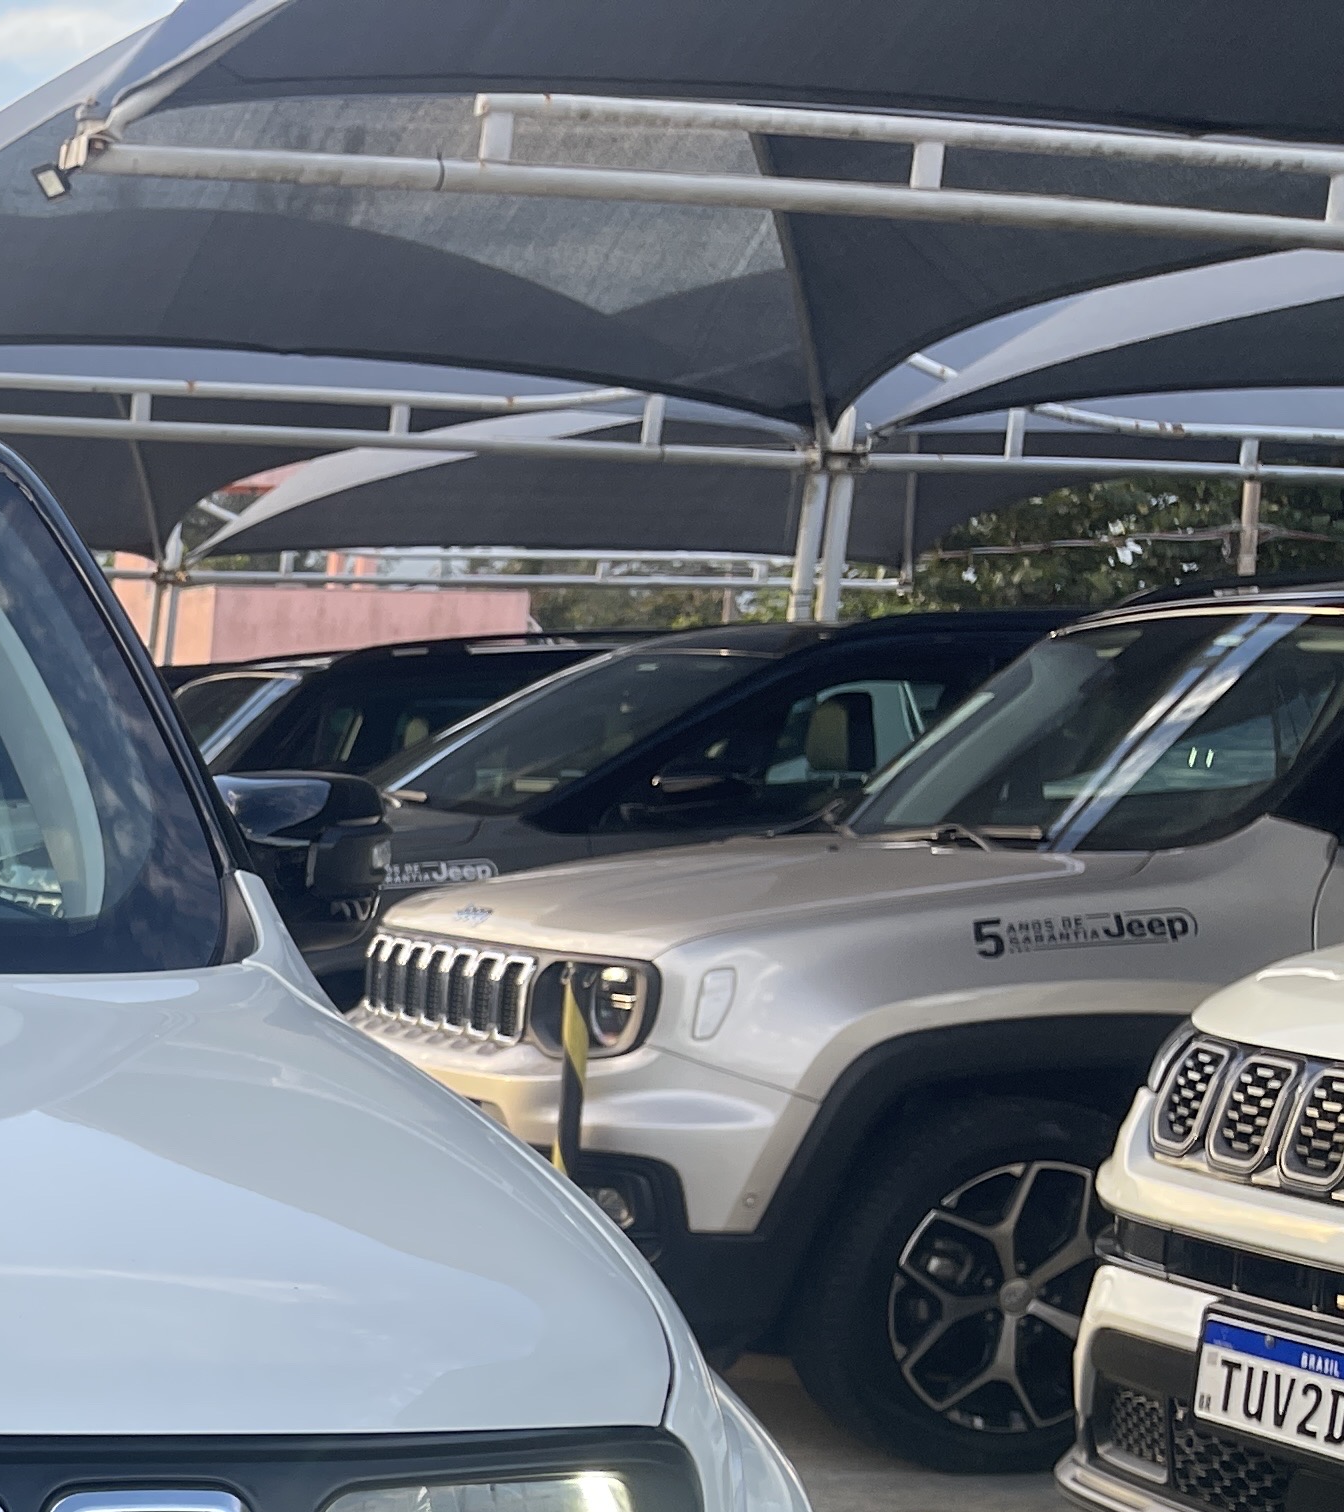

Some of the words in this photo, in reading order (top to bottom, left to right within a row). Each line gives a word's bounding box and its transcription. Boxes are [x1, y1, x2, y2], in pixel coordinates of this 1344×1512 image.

[1006, 916, 1055, 935] ANOS
[1062, 914, 1083, 929] DE
[1009, 926, 1101, 946] GARANTIA
[1103, 911, 1190, 943] Jeep
[973, 917, 1005, 959] 5
